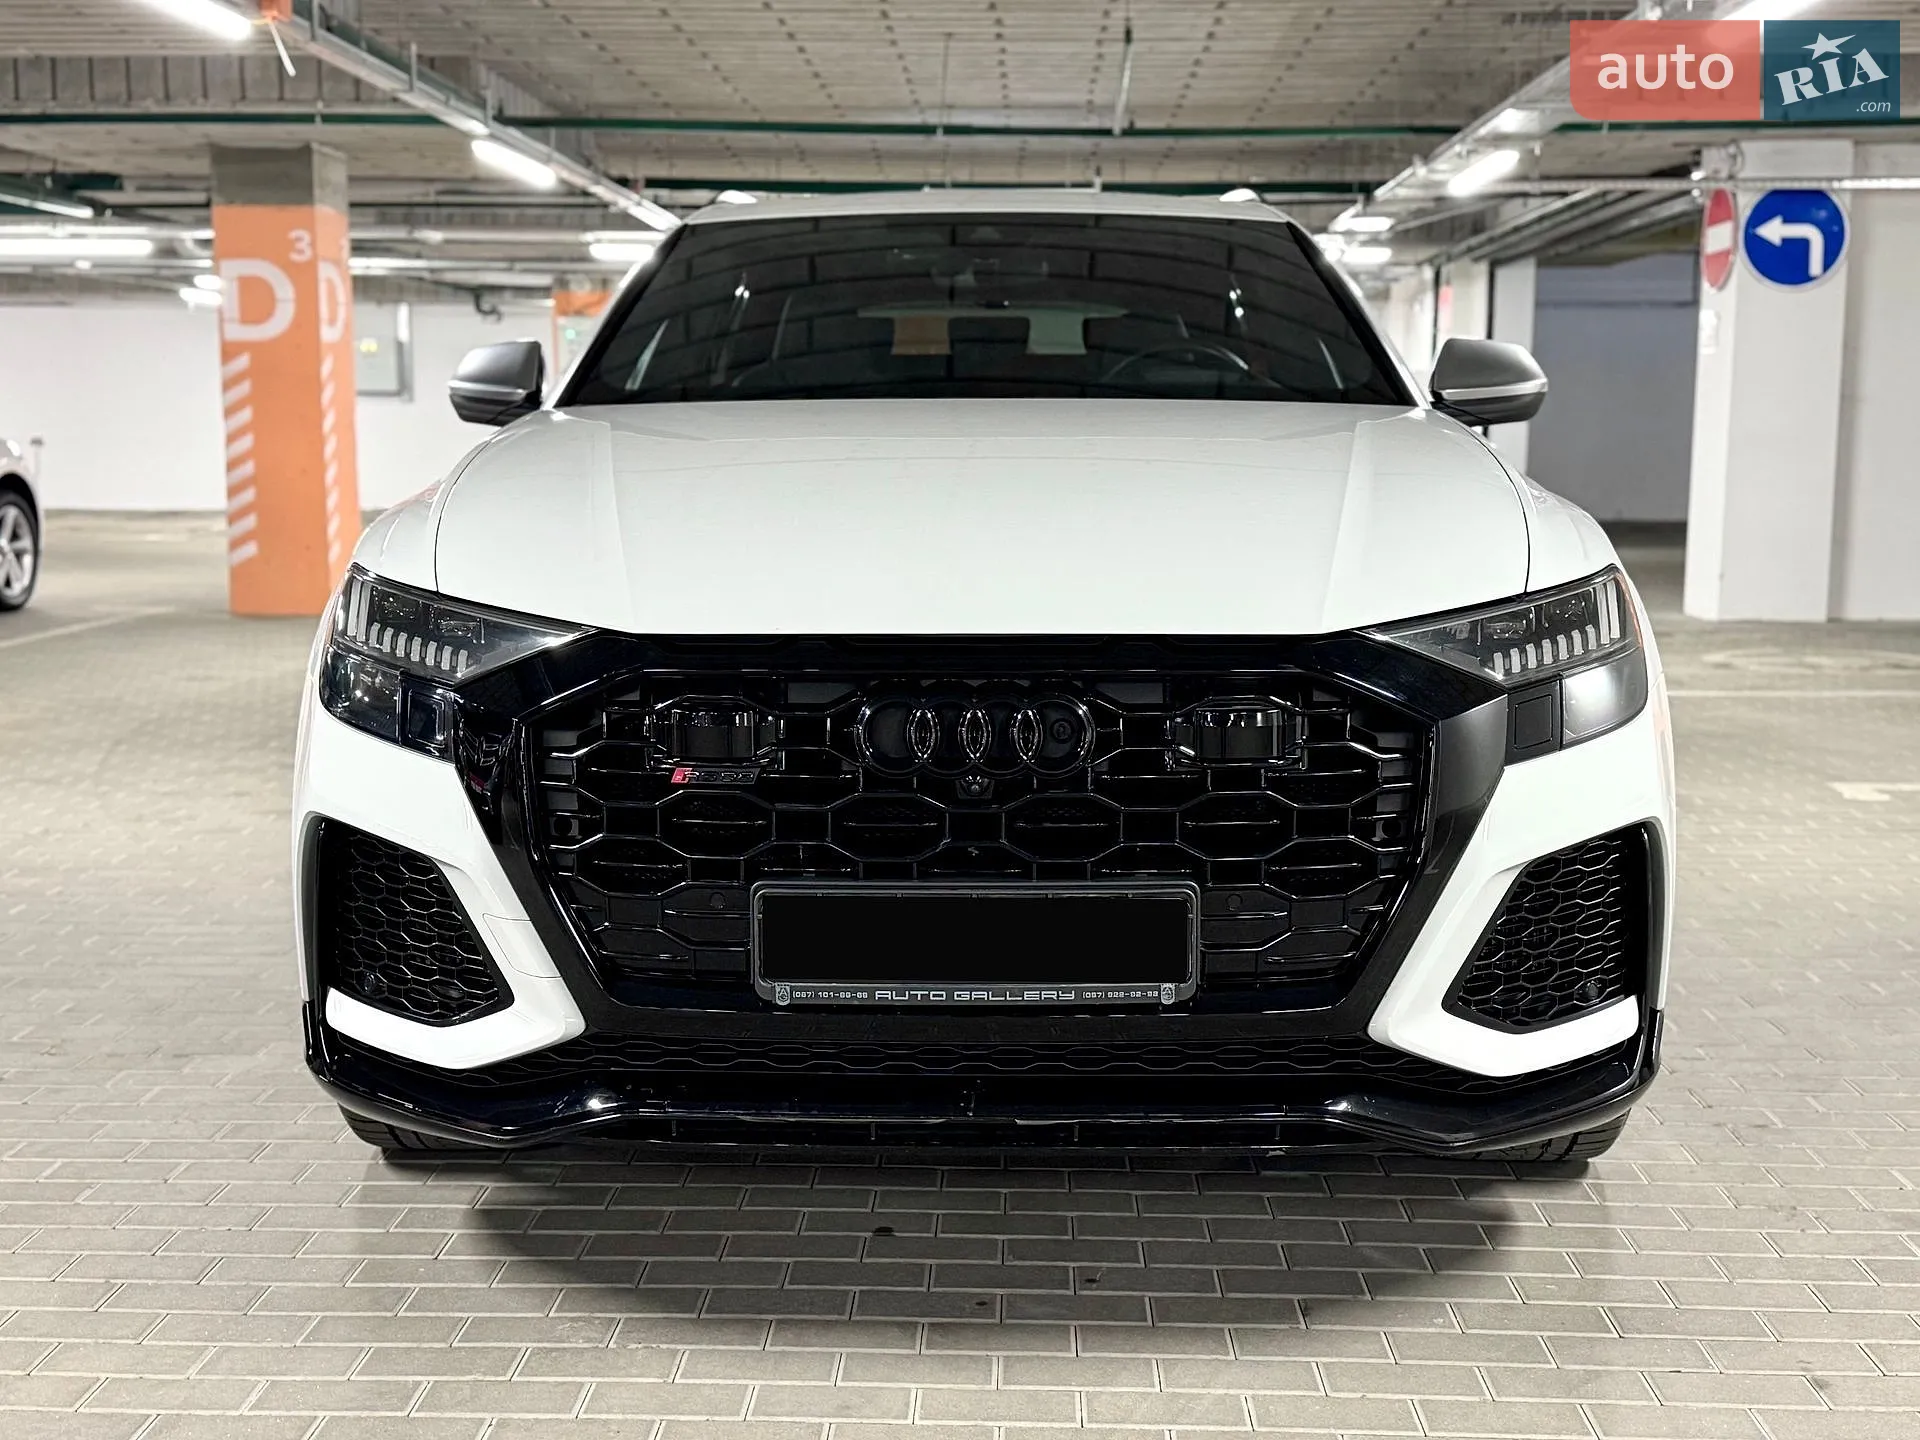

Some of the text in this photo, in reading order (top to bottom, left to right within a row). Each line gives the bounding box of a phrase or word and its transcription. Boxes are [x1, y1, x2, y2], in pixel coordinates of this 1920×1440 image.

[219, 229, 312, 341] D 3
[318, 260, 347, 343] D
[875, 990, 946, 1000] AUTO
[954, 990, 1075, 1000] GALLERY
